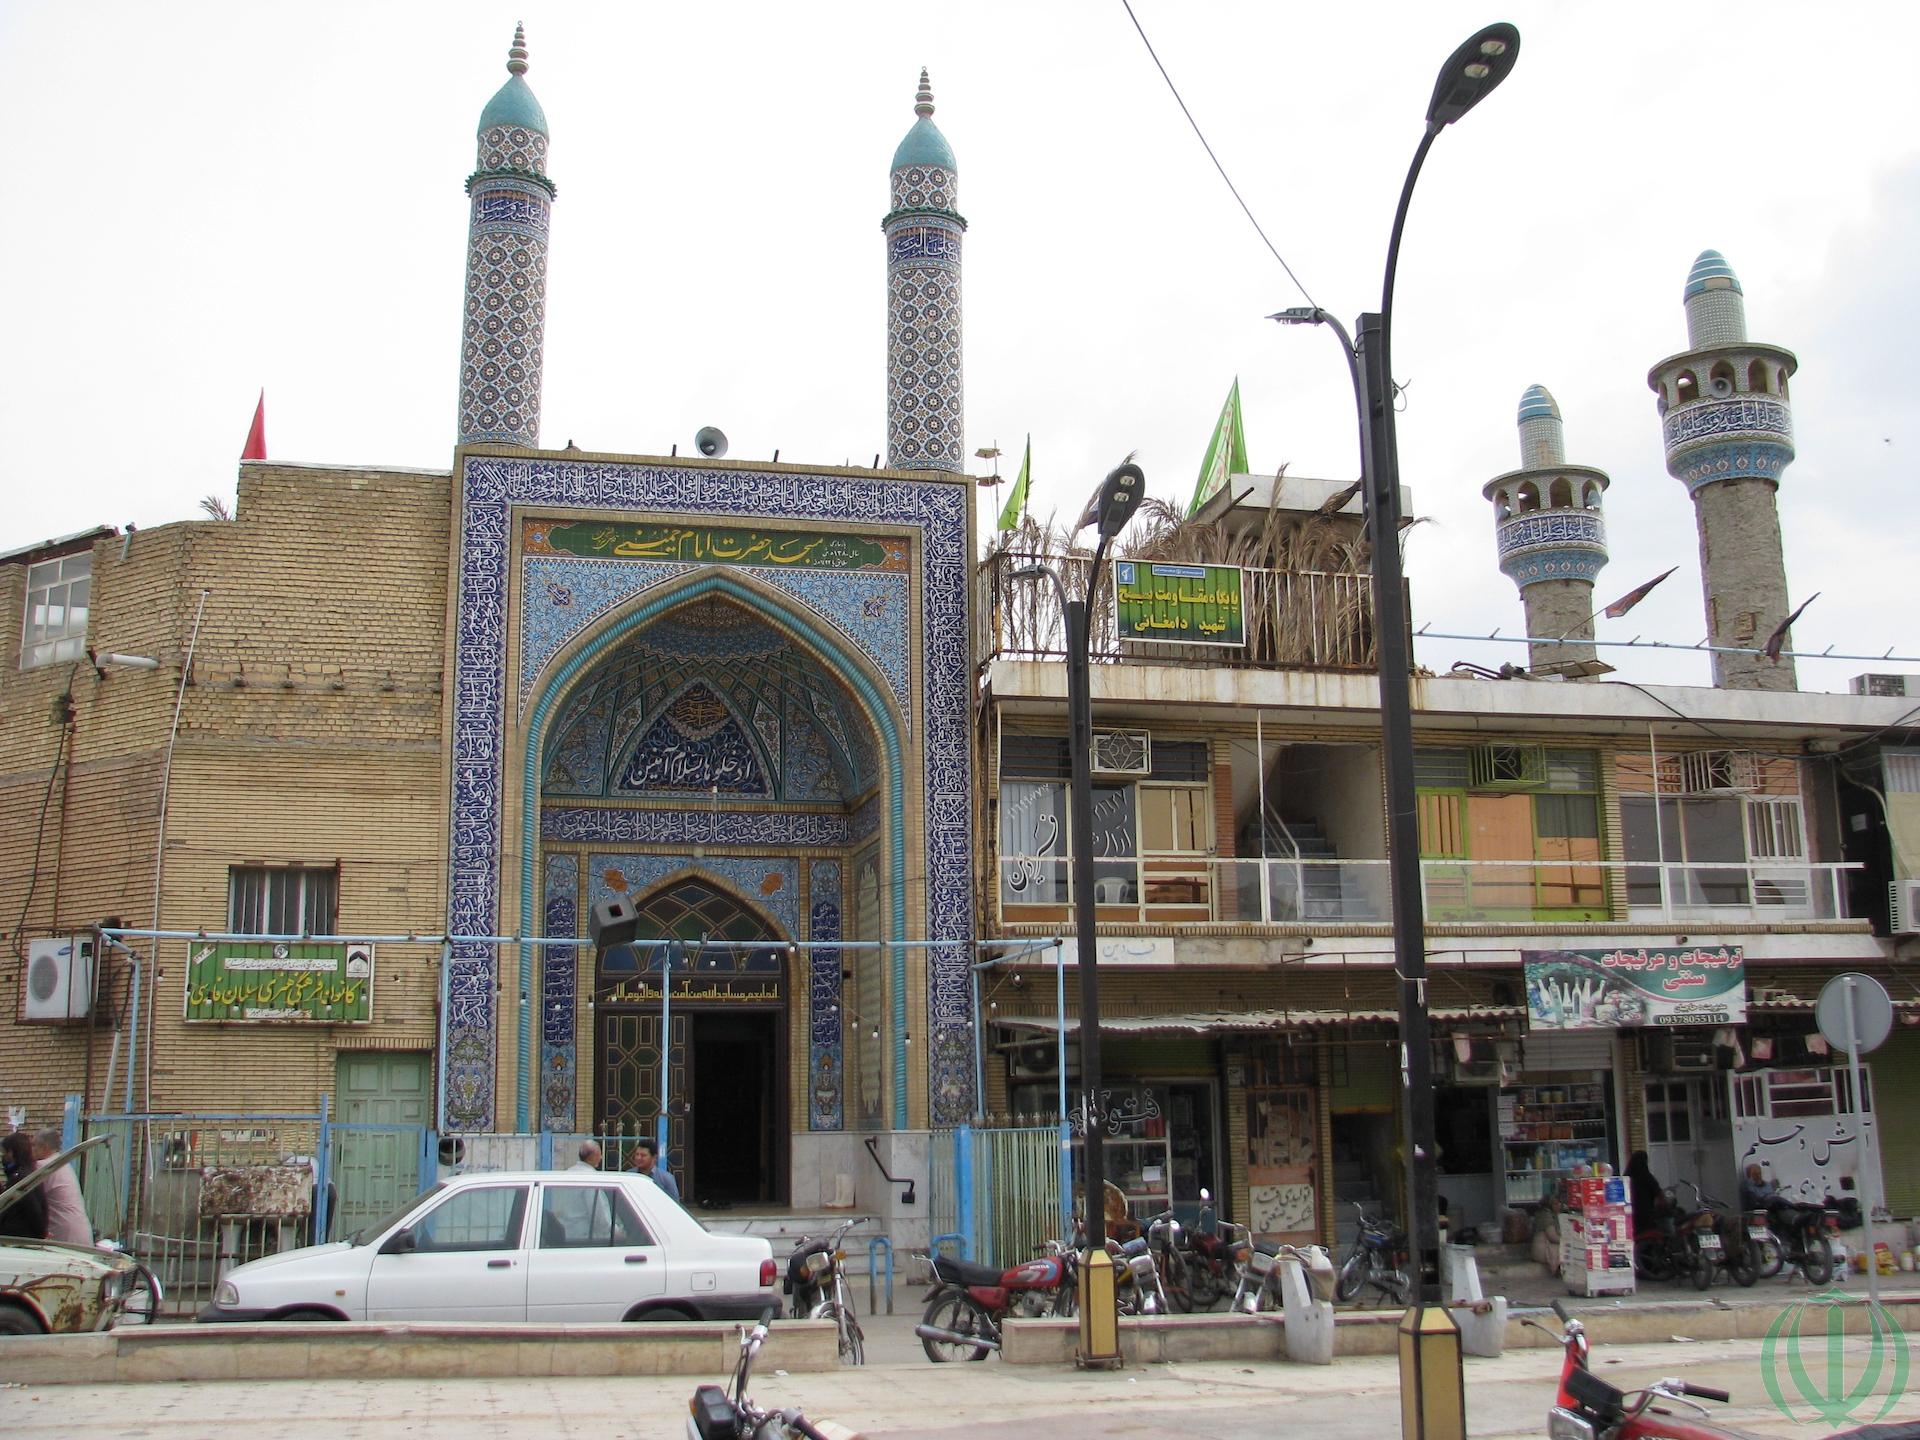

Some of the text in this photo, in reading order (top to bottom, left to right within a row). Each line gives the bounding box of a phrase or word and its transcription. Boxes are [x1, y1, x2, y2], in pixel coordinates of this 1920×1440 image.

[678, 530, 713, 561] امام
[713, 533, 772, 560] حضرت
[762, 538, 823, 563] مسجد
[1119, 586, 1239, 613] پایگاه مقاومت بسیج
[1134, 613, 1226, 635] شهید دامغانی
[1601, 946, 1744, 970] ترشیجات و عرقیجات
[258, 972, 294, 1003] هنری
[287, 970, 323, 1005] فرهنگی
[1663, 970, 1707, 990] سنتی
[222, 984, 259, 1005] سلمان
